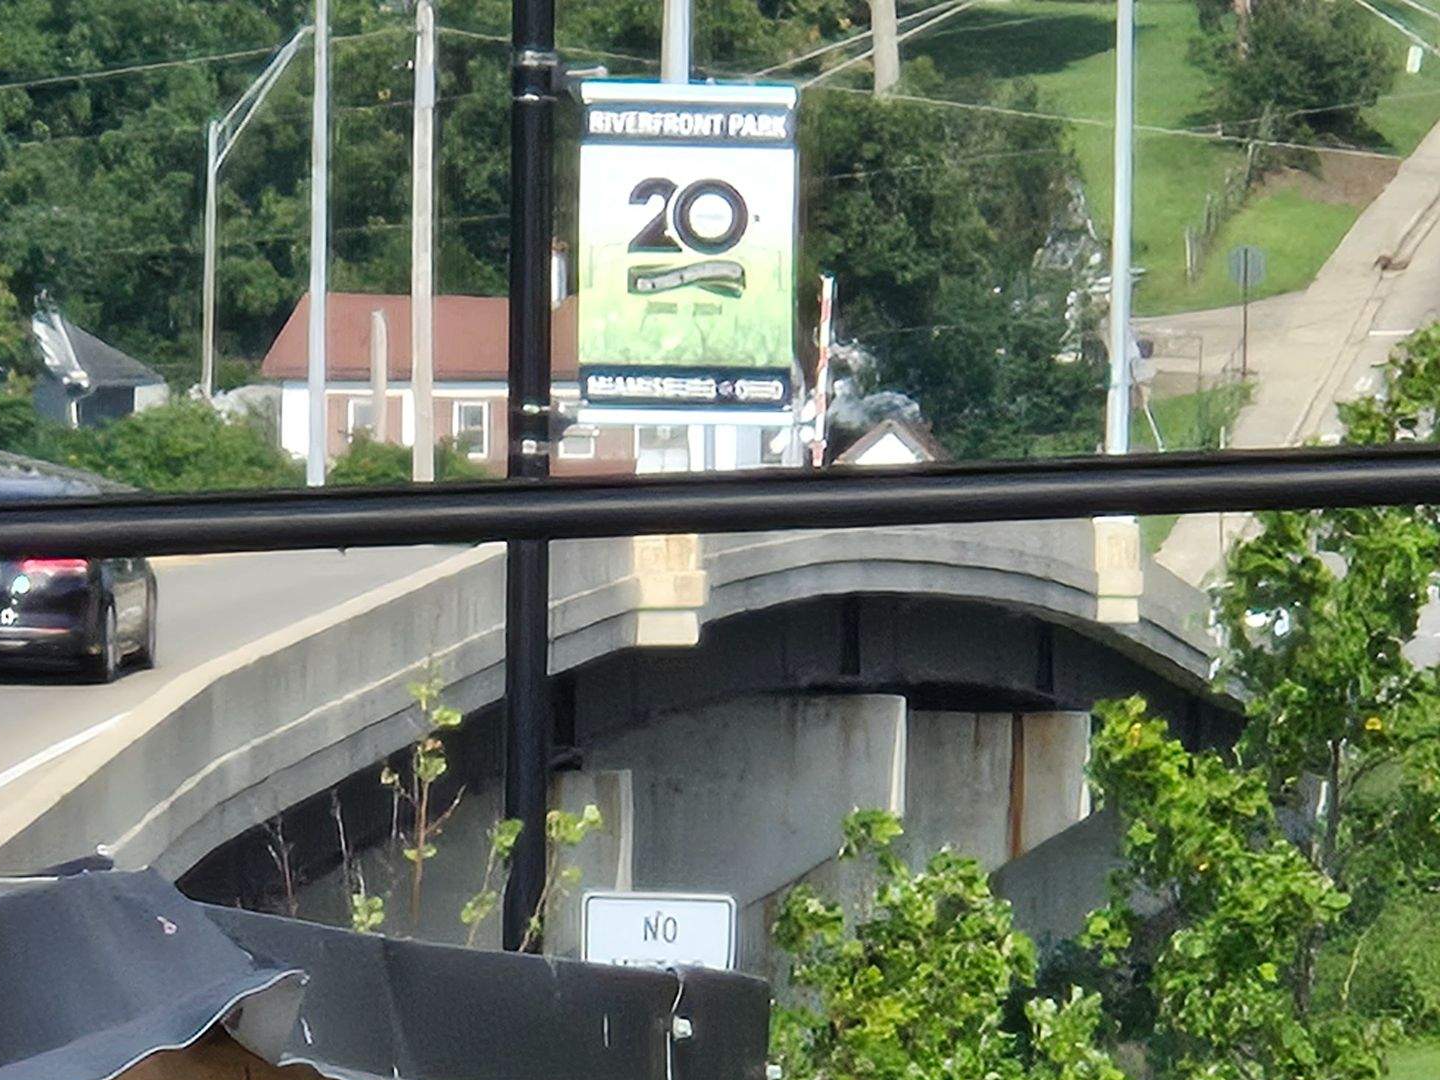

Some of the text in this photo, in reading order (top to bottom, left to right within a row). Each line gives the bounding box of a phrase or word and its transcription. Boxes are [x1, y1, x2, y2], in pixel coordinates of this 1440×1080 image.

[589, 111, 787, 138] RIVERFRONT PARK
[628, 177, 748, 255] 20
[643, 911, 677, 943] NO
